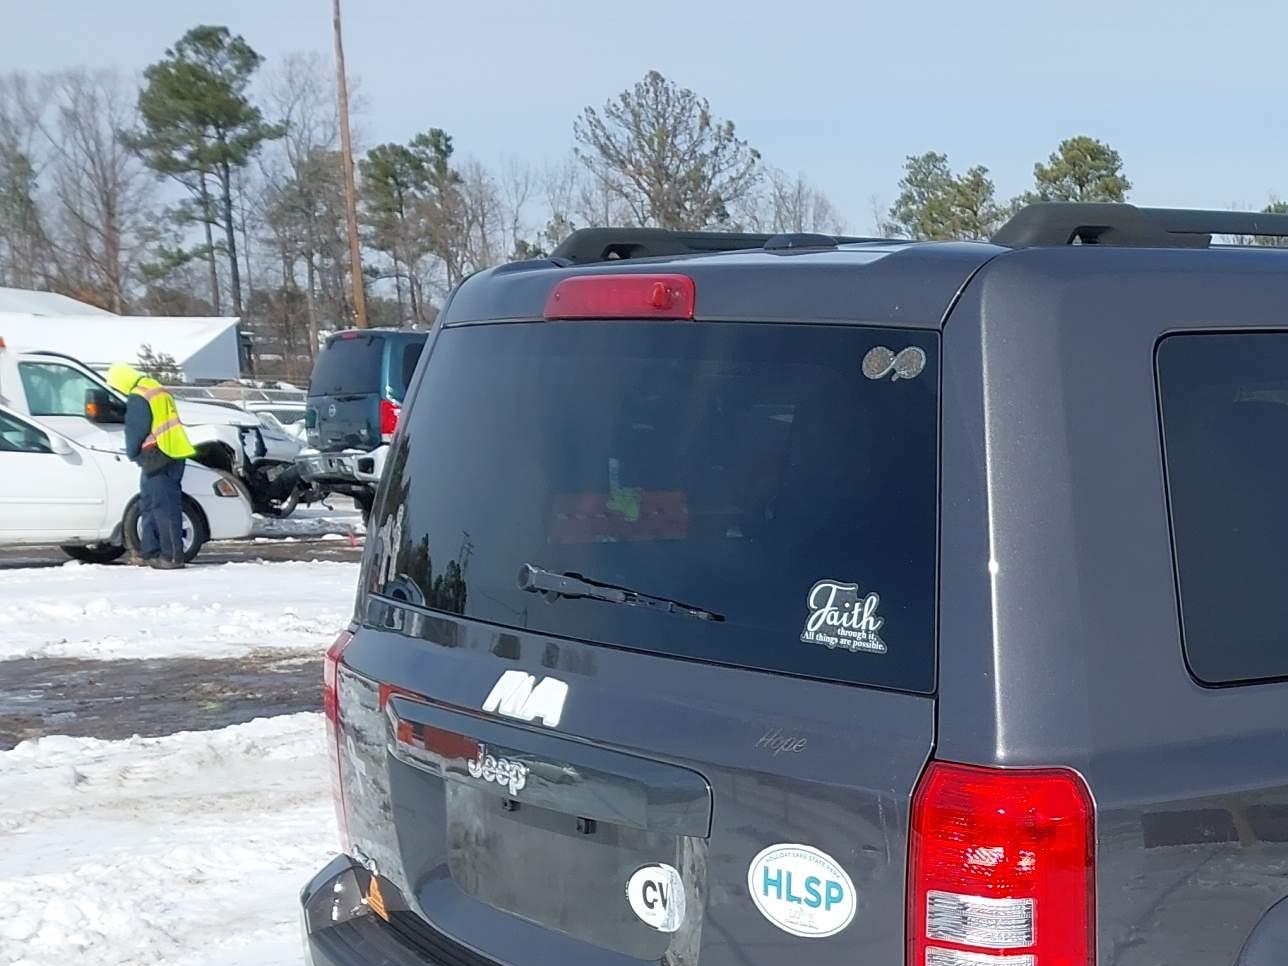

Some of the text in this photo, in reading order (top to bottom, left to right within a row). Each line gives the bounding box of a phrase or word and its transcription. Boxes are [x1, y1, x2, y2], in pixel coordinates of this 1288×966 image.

[807, 583, 881, 631] Faith
[803, 631, 885, 651] All things are possible.
[837, 627, 866, 641] through
[755, 728, 807, 757] Hope
[468, 744, 527, 796] Jeep
[763, 865, 844, 911] HLSP
